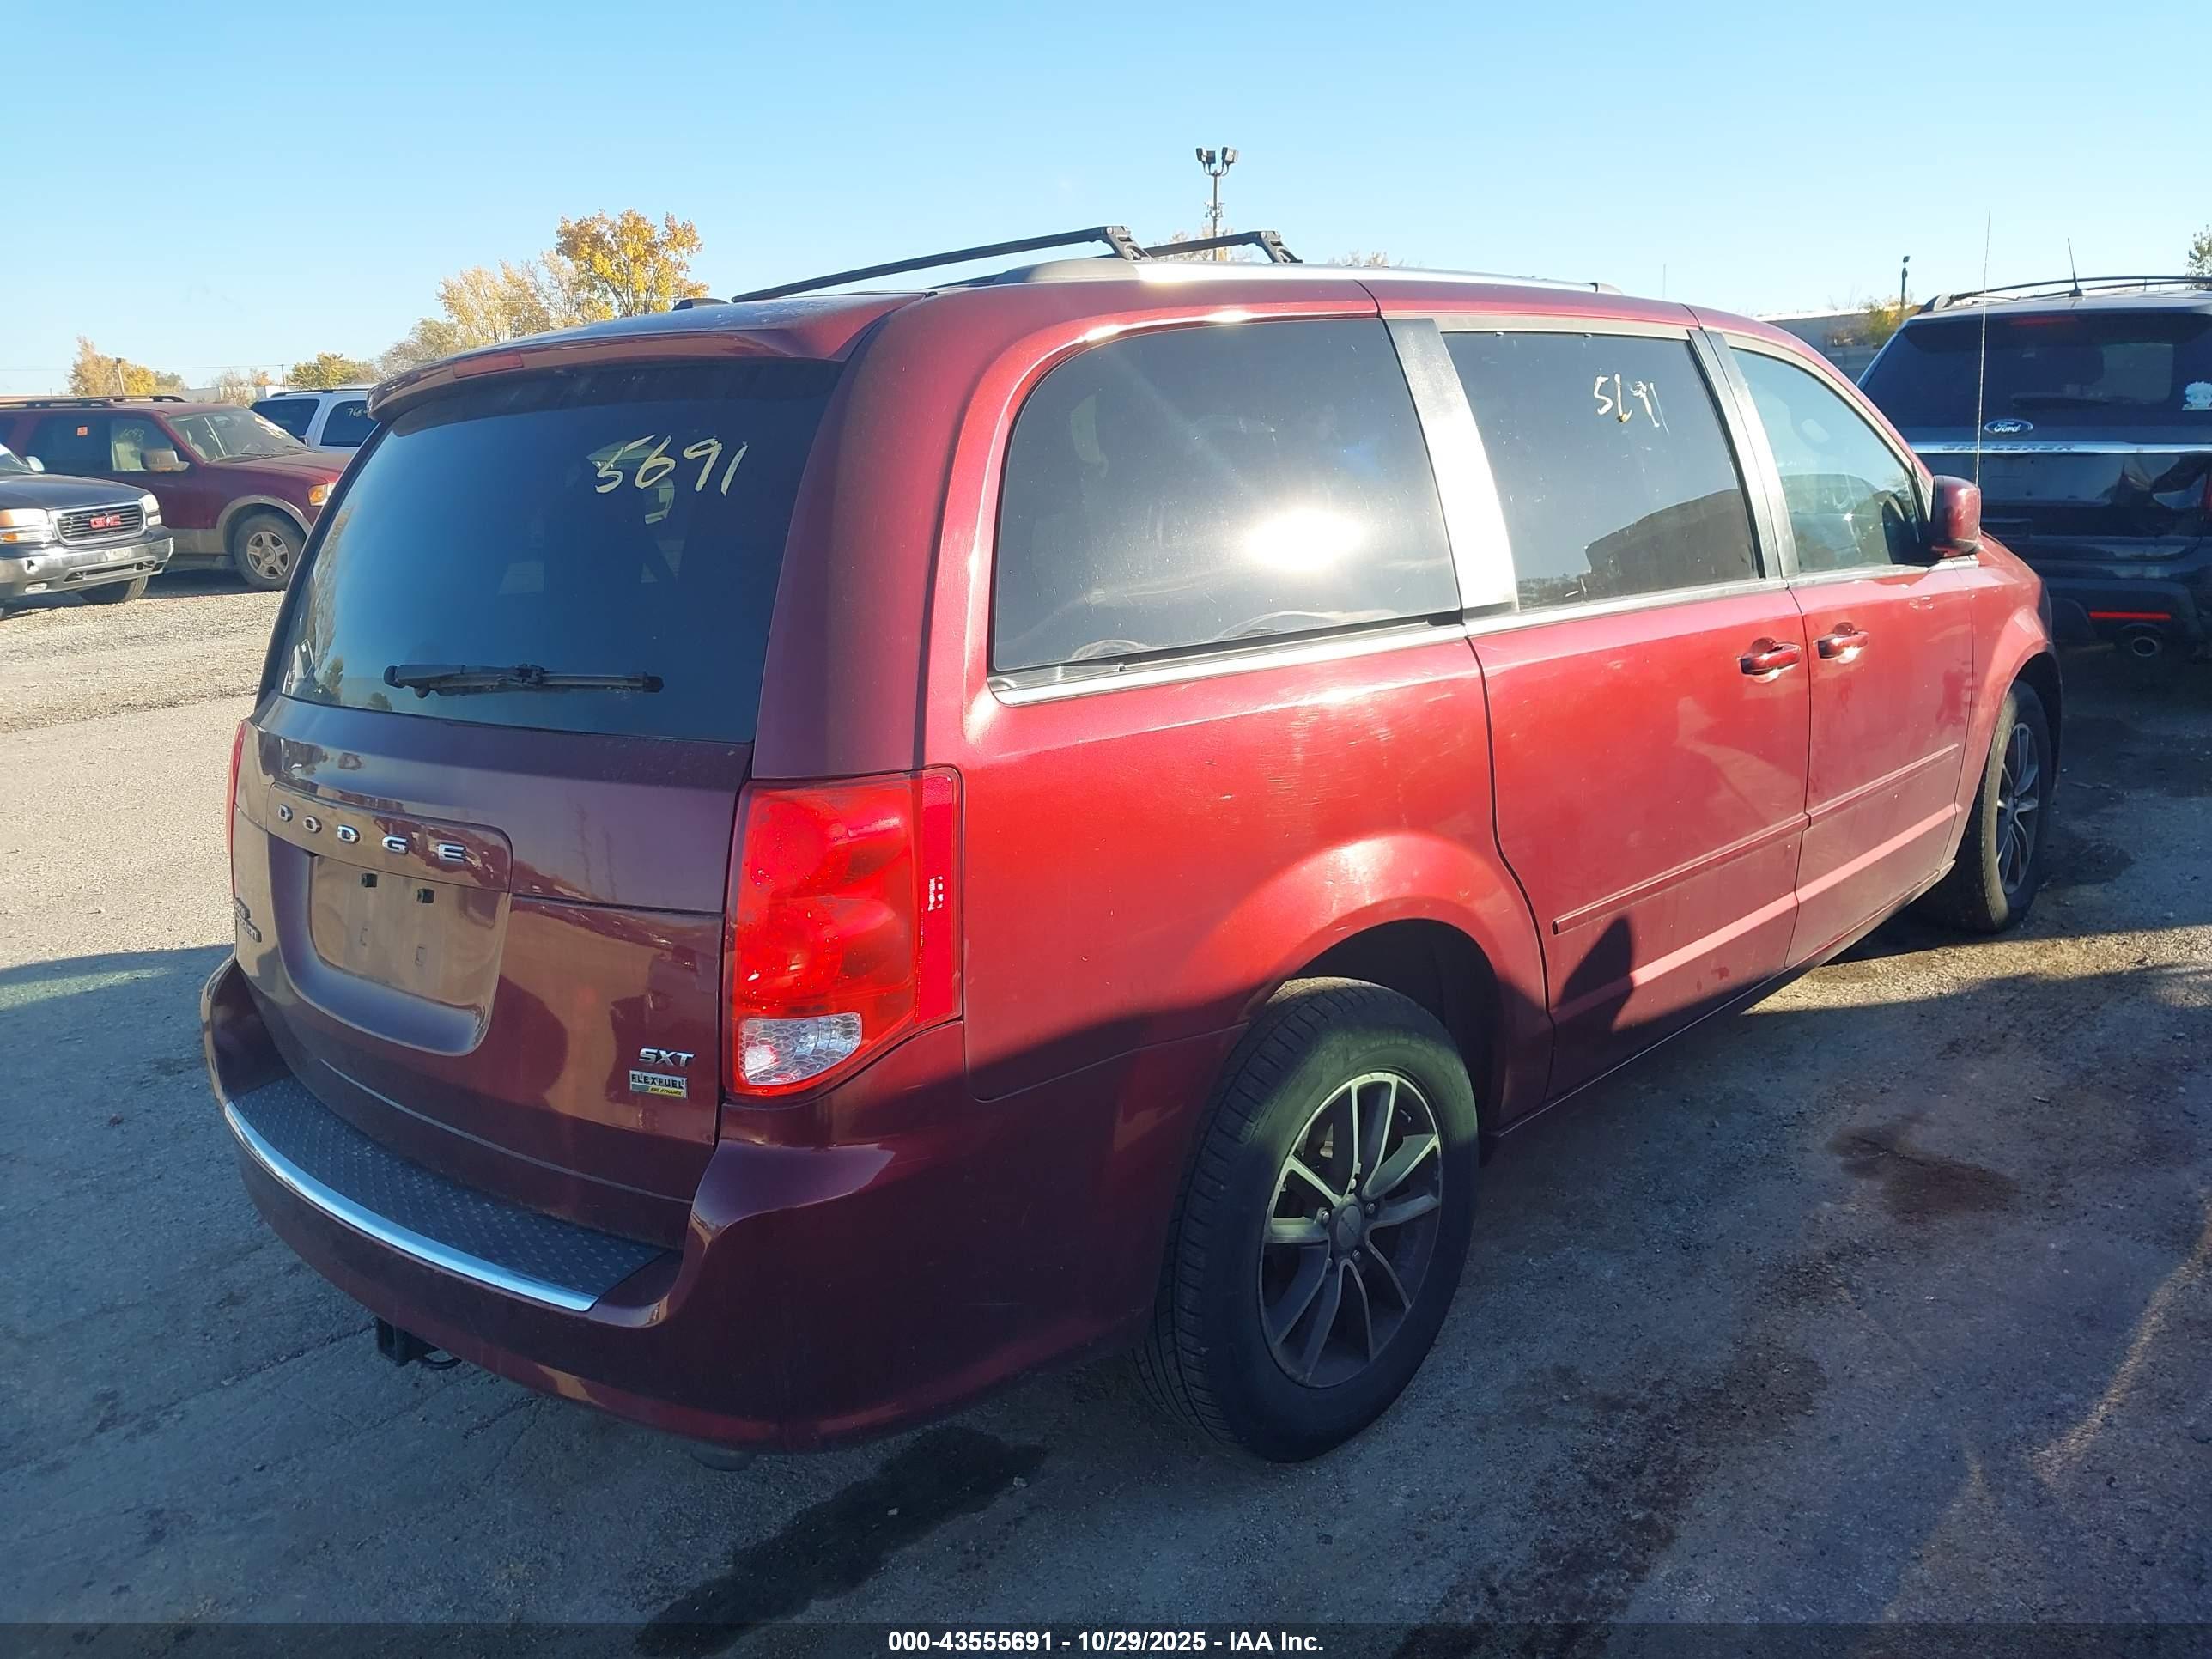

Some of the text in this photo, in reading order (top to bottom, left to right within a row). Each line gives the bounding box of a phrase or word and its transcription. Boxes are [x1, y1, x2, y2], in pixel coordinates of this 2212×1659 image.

[595, 434, 748, 496] 5691
[278, 804, 467, 864] DODGE
[638, 1048, 695, 1067] SXT
[631, 1073, 684, 1089] FLEXFUEL
